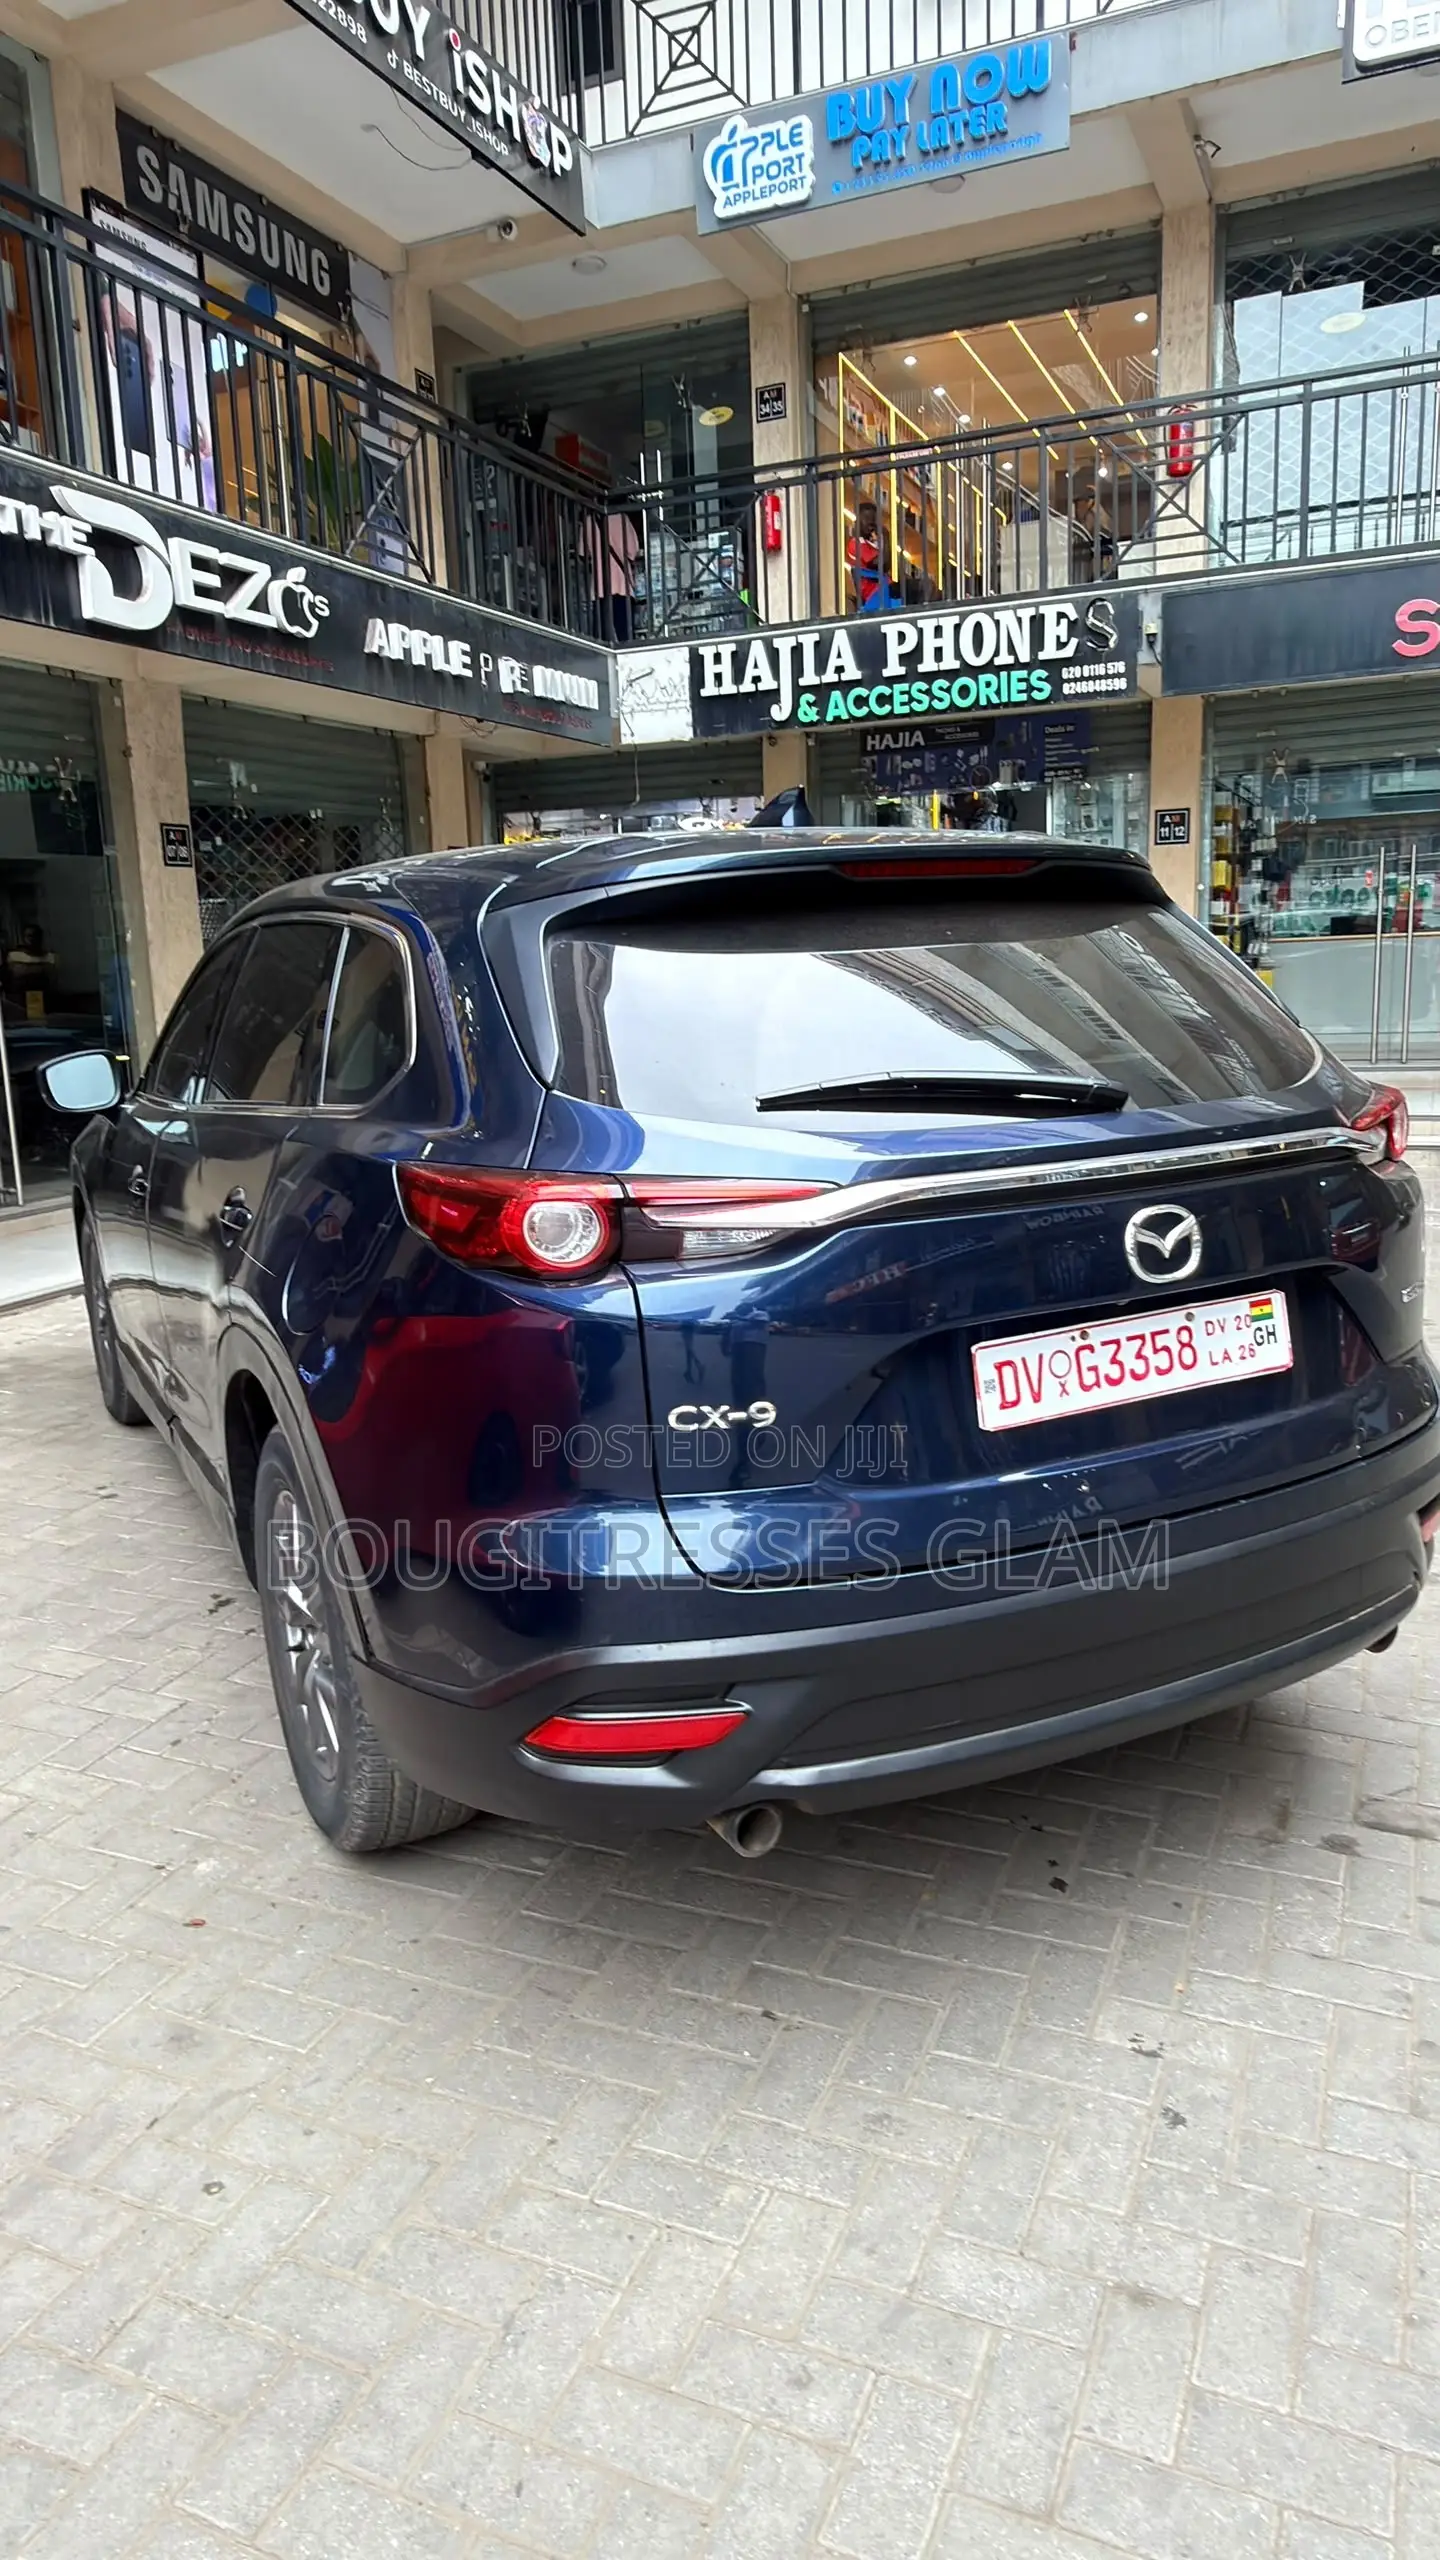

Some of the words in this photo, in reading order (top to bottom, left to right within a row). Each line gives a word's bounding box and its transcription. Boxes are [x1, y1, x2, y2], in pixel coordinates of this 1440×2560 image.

[826, 74, 918, 143] BUY
[852, 125, 911, 171] PAY
[916, 101, 1008, 153] LATER
[752, 152, 805, 187] PORT
[722, 176, 807, 209] APPLEPORT
[136, 145, 331, 297] SAMSUNG
[363, 618, 473, 678] APPLE
[698, 629, 862, 722] HAJIA
[881, 597, 1119, 678] PHONES
[797, 693, 820, 723] &
[825, 669, 1052, 722] ACCESSORIES
[866, 730, 925, 751] HAJIA
[1160, 826, 1170, 838] 11
[1173, 825, 1185, 837] 12
[1204, 1317, 1227, 1337] DV
[1235, 1313, 1252, 1332] 20
[1253, 1323, 1279, 1348] GH
[993, 1352, 1044, 1411] DV
[1075, 1324, 1198, 1393] G3358
[1208, 1348, 1233, 1367] LA
[1238, 1342, 1257, 1361] 26
[667, 1400, 777, 1432] CX-9
